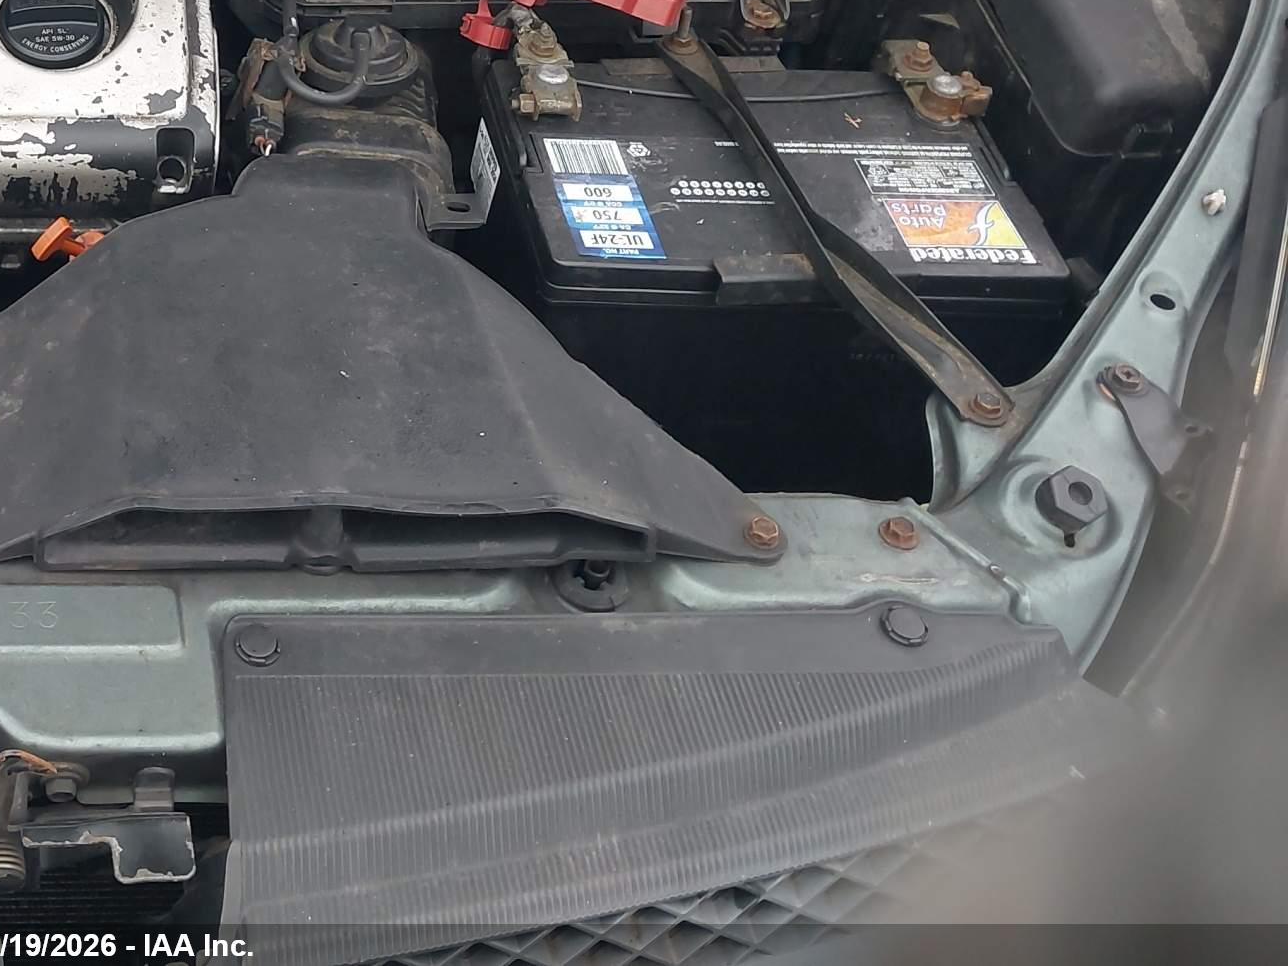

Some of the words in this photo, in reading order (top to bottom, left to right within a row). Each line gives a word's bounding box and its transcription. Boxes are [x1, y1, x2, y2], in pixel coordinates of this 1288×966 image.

[22, 37, 47, 52] ENERGY
[50, 35, 89, 53] CONSERVING
[584, 187, 612, 197] 600
[593, 210, 622, 220] 750
[891, 202, 946, 216] Parts
[900, 216, 946, 228] Auto
[592, 234, 644, 246] UL-24F
[909, 248, 1037, 264] Federated
